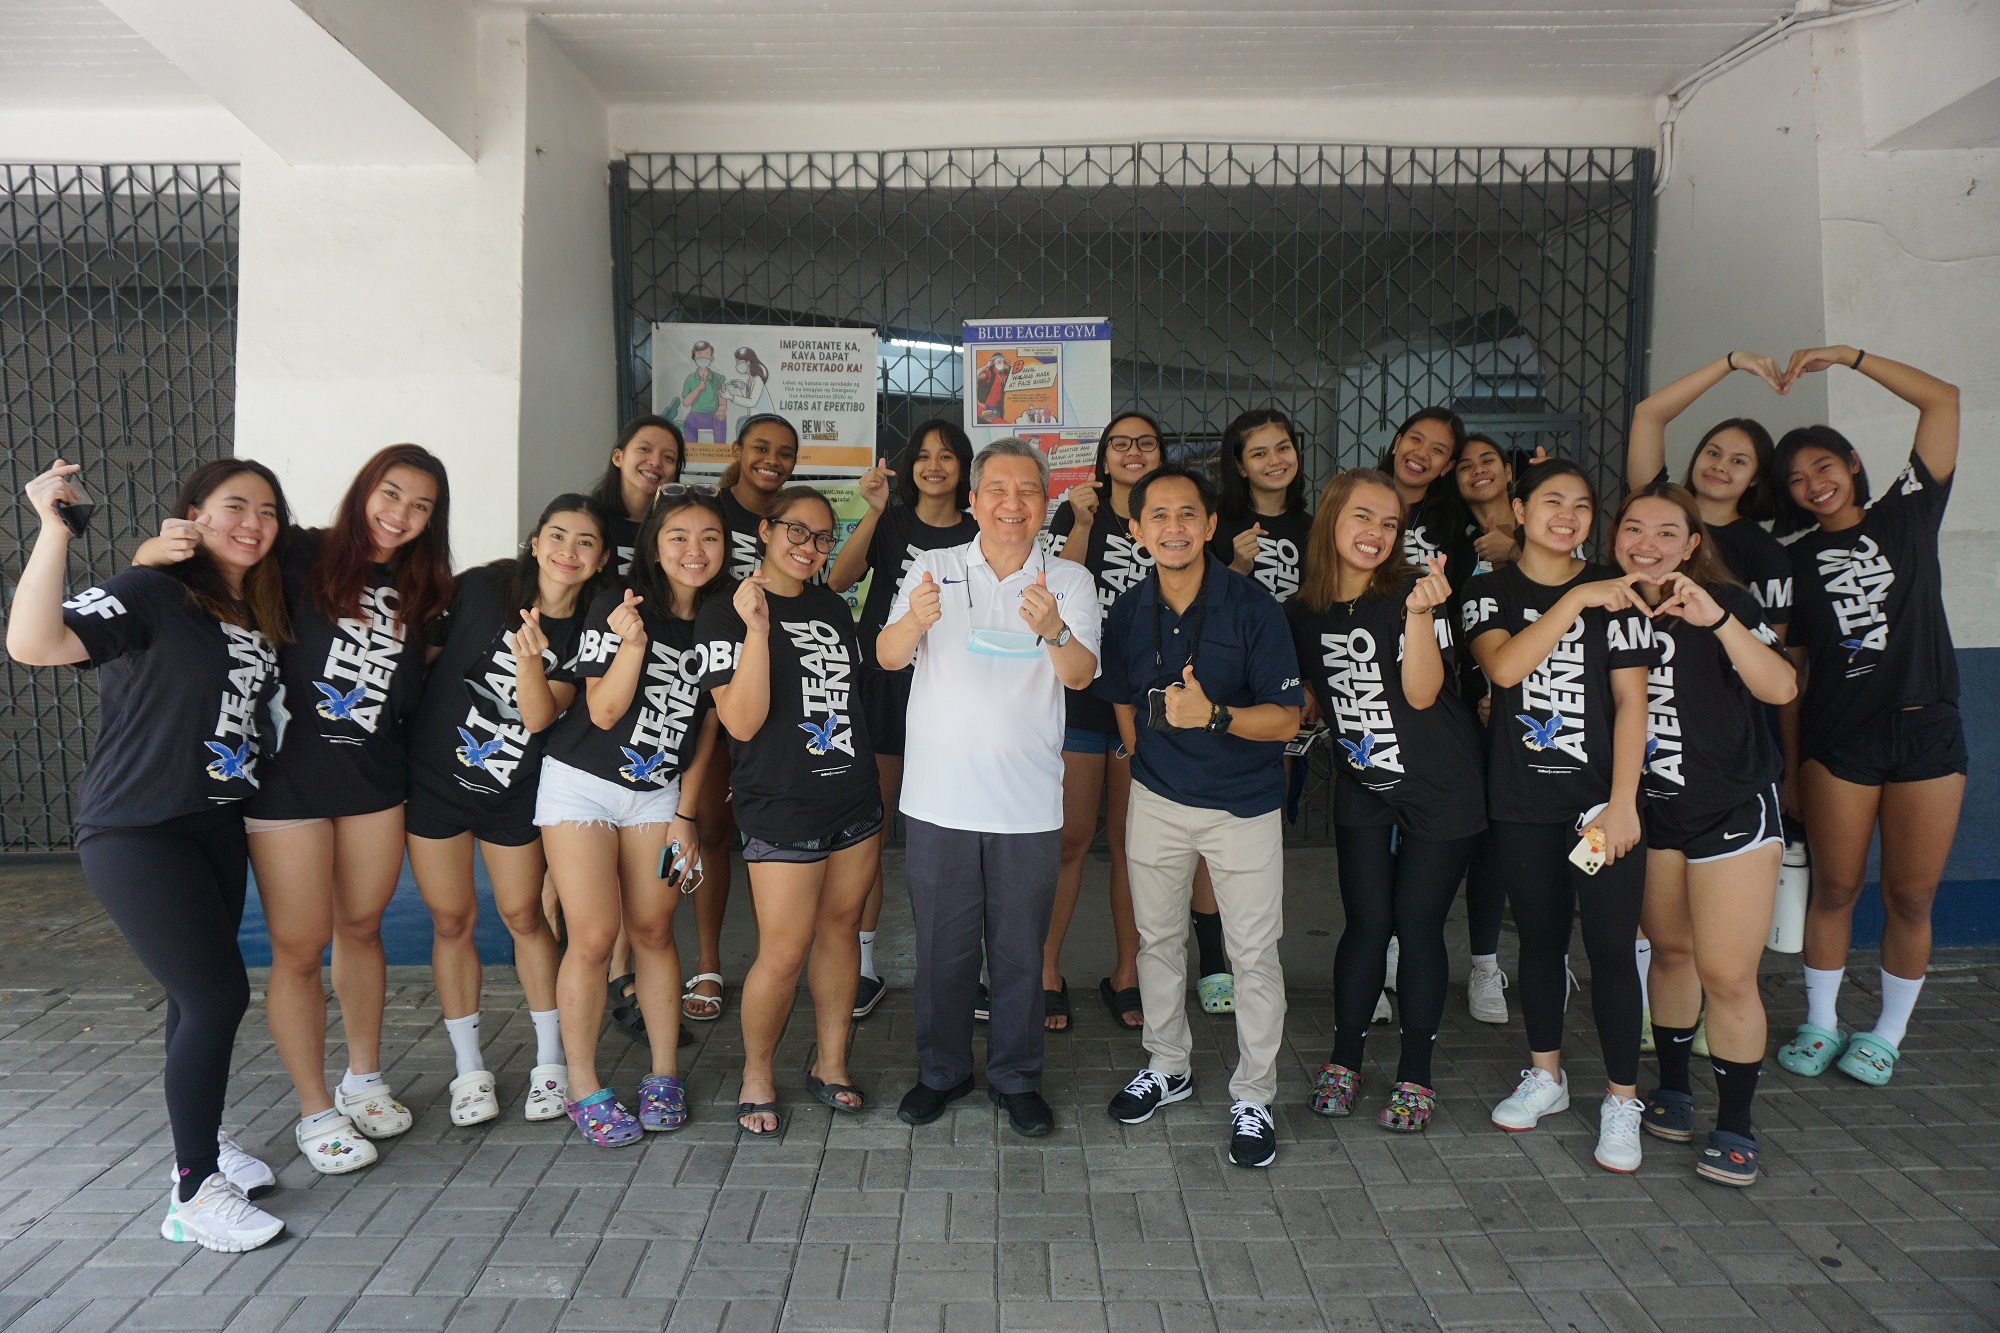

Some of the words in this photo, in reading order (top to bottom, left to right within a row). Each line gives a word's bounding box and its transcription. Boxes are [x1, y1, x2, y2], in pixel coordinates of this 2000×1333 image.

[779, 339, 842, 351] IMPORTANTE
[844, 341, 860, 352] KA,
[791, 350, 816, 360] KAYA
[818, 351, 850, 361] DAPAT
[978, 326, 1013, 339] BLUE
[1016, 325, 1061, 339] EAGLE
[1064, 324, 1097, 338] GYM
[780, 361, 844, 372] PROTEKTADO
[846, 363, 863, 373] KA!
[1033, 377, 1052, 385] SHIELD
[1035, 370, 1051, 378] MASK
[779, 400, 810, 411] LIGTAS
[811, 400, 822, 411] AT
[824, 401, 866, 413] EPEKTIBO
[802, 419, 813, 434] BE
[1254, 536, 1278, 597] AM
[1275, 538, 1300, 604] NEO
[1816, 548, 1874, 636] TEAM
[215, 621, 258, 738] TEAM
[350, 586, 407, 734] ATENEO
[780, 621, 829, 718] TEAM
[808, 619, 856, 758] ATENEO
[1320, 632, 1365, 734] TEAM
[629, 640, 682, 747] TEAM
[649, 648, 701, 788] ATENEO
[1347, 627, 1406, 774] ATENEO
